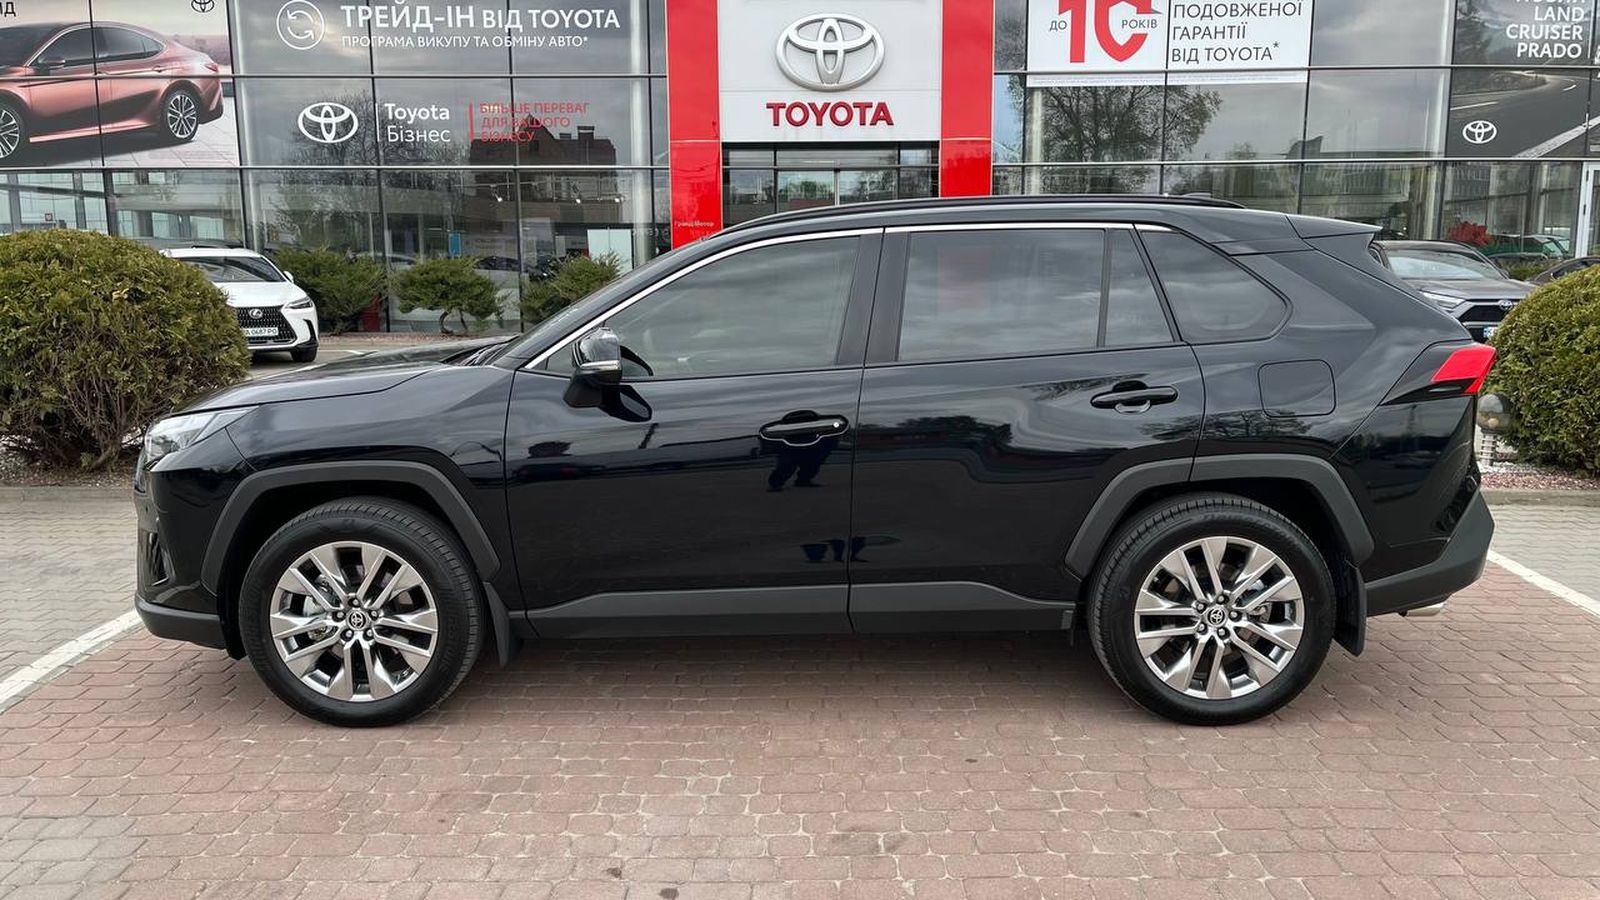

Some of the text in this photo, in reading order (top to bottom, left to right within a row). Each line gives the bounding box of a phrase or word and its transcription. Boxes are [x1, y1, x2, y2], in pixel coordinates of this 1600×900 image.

[1173, 0, 1303, 20] ПОДОВЖЕНОЇ
[1534, 6, 1584, 21] LAND
[482, 9, 523, 33] ВІД
[527, 9, 620, 29] TOYOTA
[1049, 20, 1068, 31] ДО
[1121, 18, 1158, 29] РОКІВ
[1173, 21, 1248, 41] ГАРАНТІЇ
[1506, 24, 1583, 40] CRUISER
[341, 35, 414, 48] ПРОГРАМА
[417, 35, 471, 48] ВИКУПУ
[473, 35, 489, 47] ТА
[492, 35, 546, 48] ОБМІНУ
[1171, 48, 1200, 64] ВІД
[1516, 42, 1582, 58] PRADO
[385, 103, 450, 125] Toyota
[534, 102, 590, 114] ПЕРЕВАГ
[766, 101, 894, 127] TOYOTA
[481, 117, 508, 130] ДЛЯ
[387, 124, 451, 143] Бізнес
